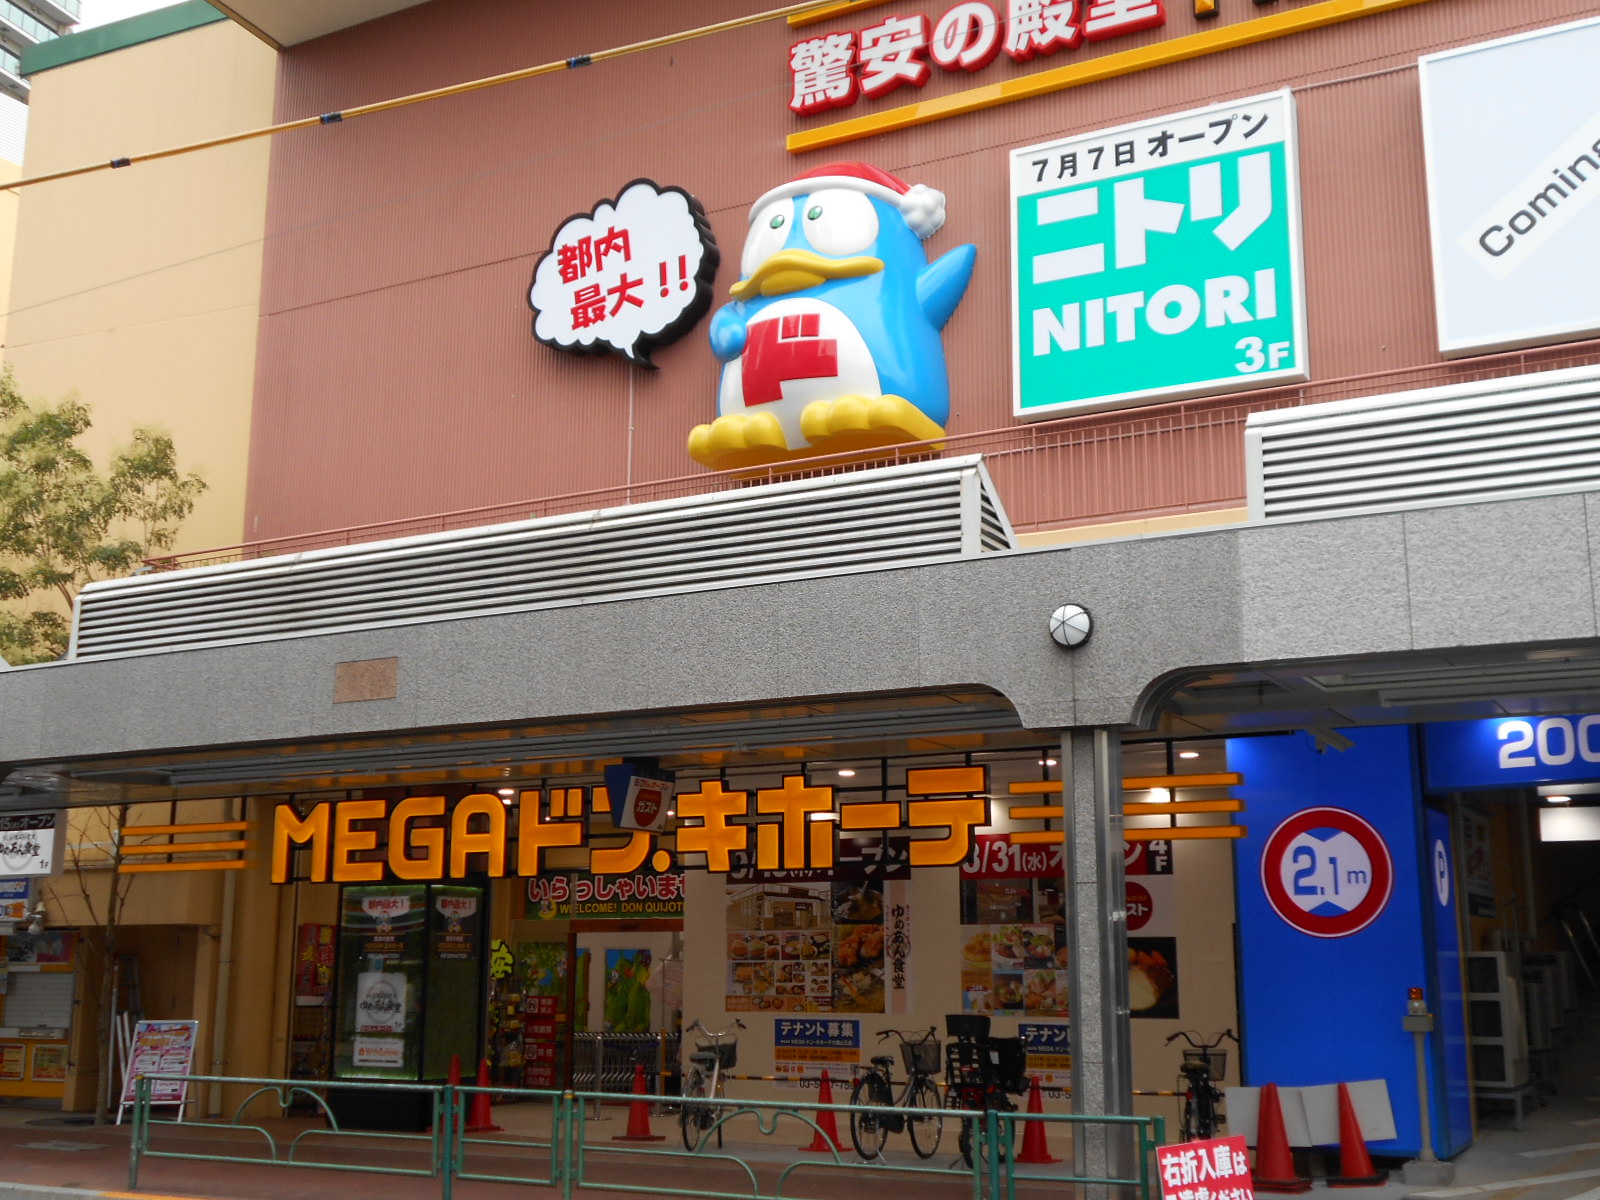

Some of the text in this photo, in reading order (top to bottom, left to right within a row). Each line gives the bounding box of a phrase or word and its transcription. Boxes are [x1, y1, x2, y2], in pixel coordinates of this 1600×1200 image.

[1032, 150, 1273, 285] ニトリ
[557, 225, 632, 285] 都内
[1032, 267, 1277, 357] NITORI
[1234, 336, 1291, 374] 3F
[636, 800, 658, 814] ガスト
[1292, 845, 1367, 896] 2.1m
[559, 902, 617, 914] WELCOME!
[621, 901, 643, 913] DON
[891, 903, 906, 990] ゆめあん食堂
[780, 1021, 854, 1038] テナント募集
[1161, 1144, 1248, 1188] 右折入庫は
